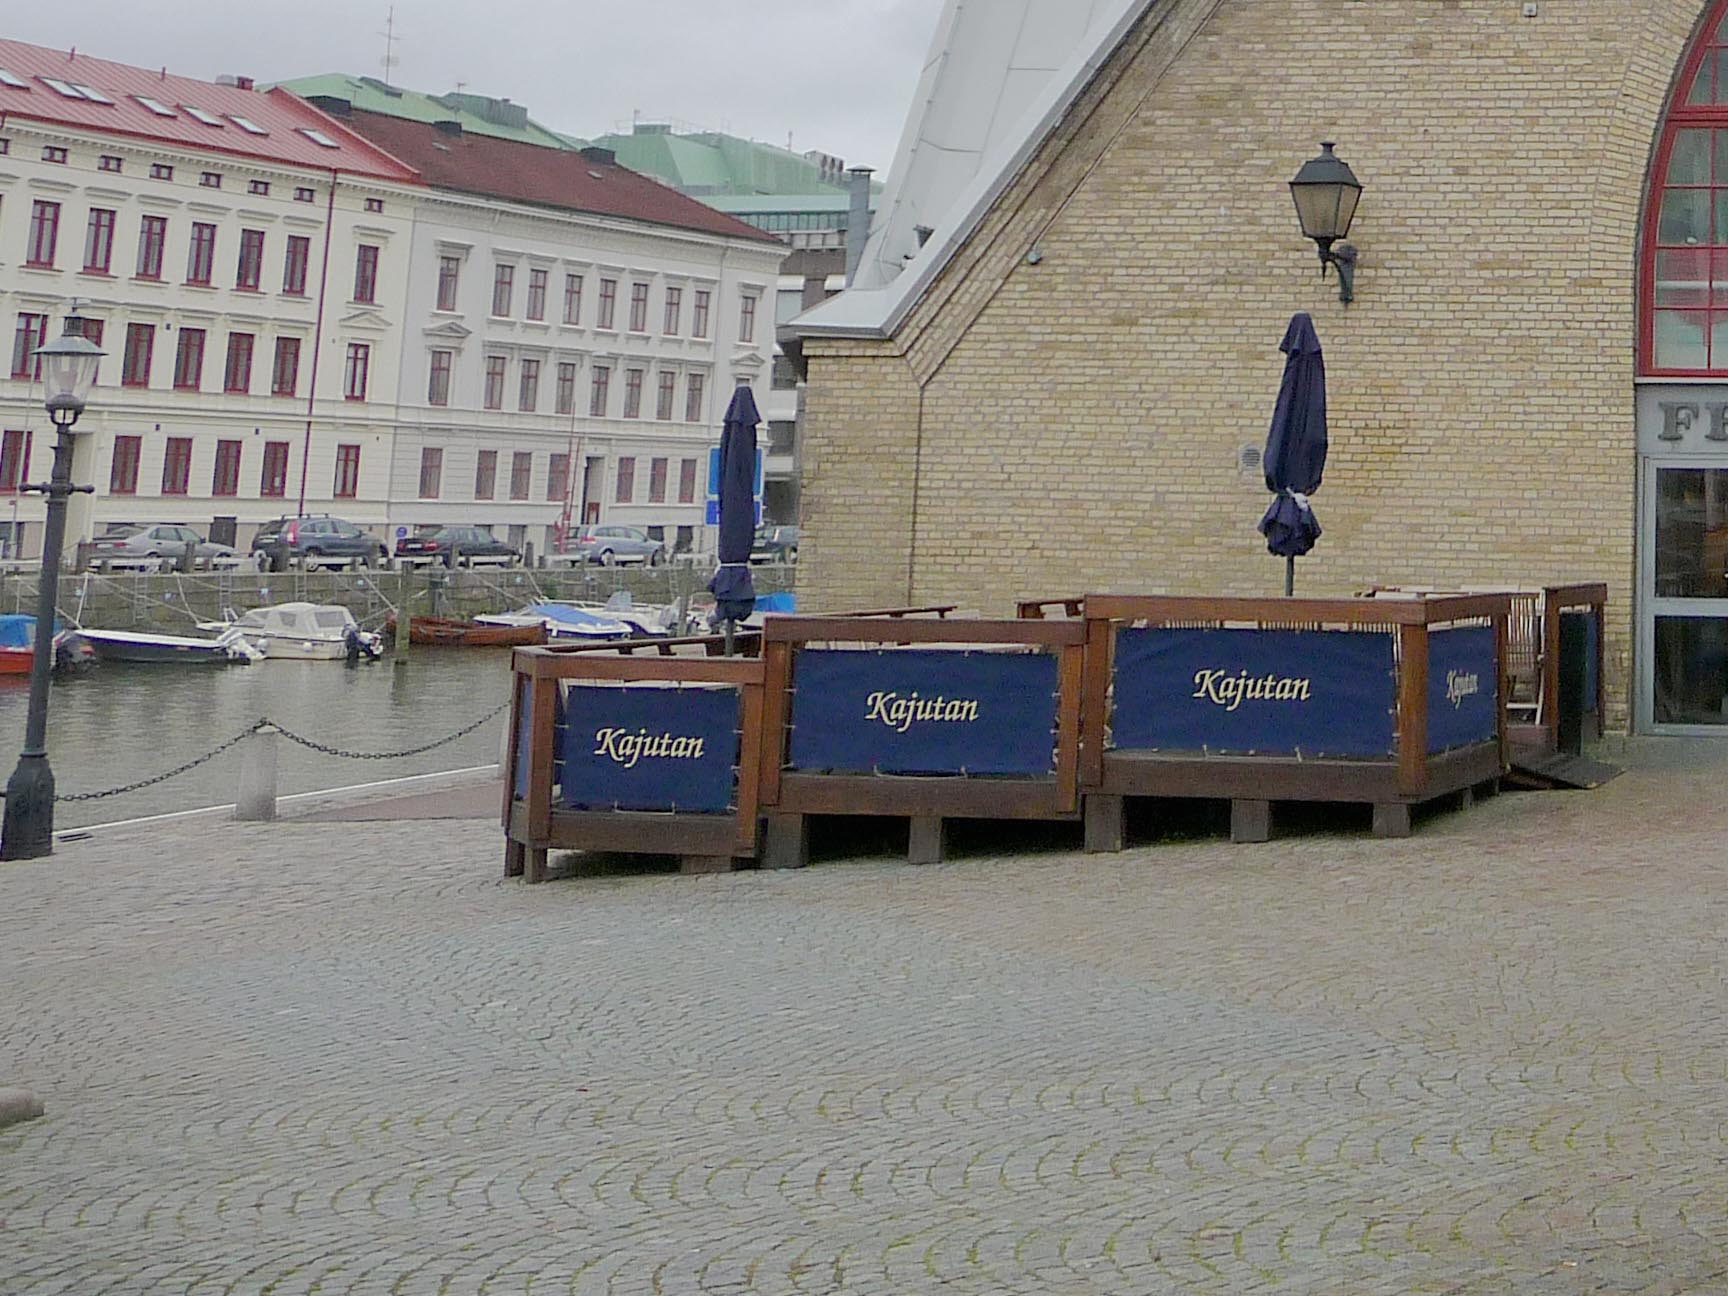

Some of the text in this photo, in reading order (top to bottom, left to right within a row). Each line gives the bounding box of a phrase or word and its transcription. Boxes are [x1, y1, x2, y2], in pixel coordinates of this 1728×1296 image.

[1193, 669, 1311, 710] Kajutan
[865, 690, 979, 732] Kajutan
[594, 727, 704, 768] Kajutan
